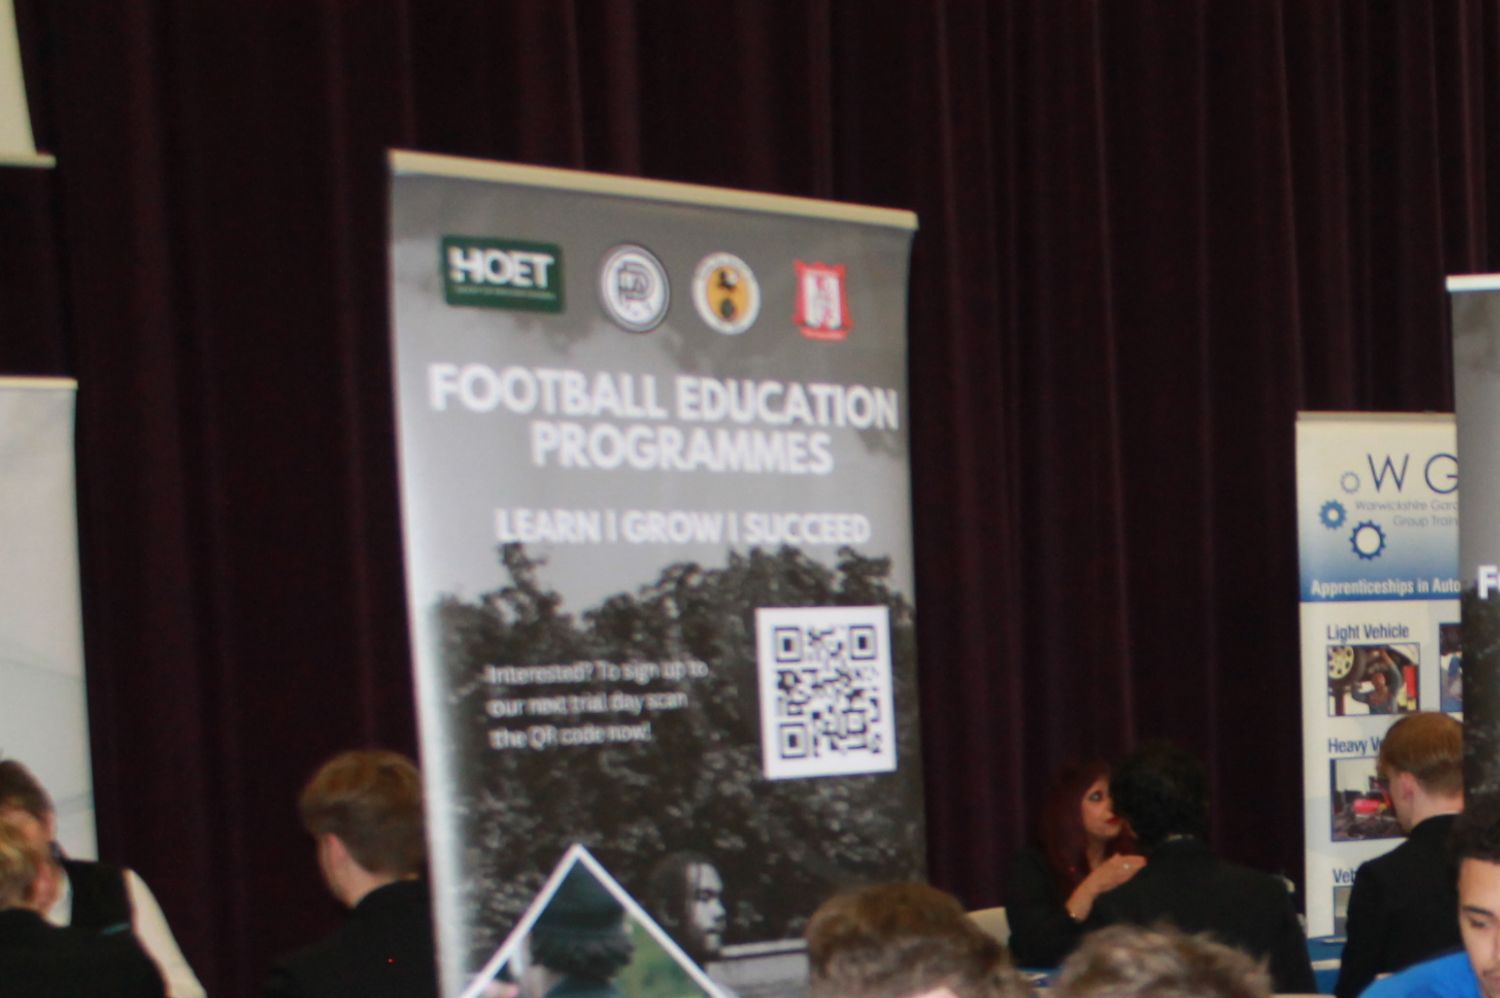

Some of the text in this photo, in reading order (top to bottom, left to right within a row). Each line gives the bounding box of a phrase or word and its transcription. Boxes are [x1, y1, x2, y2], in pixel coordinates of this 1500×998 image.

[449, 246, 556, 289] HOET
[429, 363, 899, 430] FOOTBALL EDUCATION
[530, 419, 834, 475] PROGRAMMES
[494, 510, 598, 543] LEARN
[622, 512, 723, 543] GROW
[744, 512, 870, 544] SUCCEED
[1311, 579, 1414, 598] Apprenticeships
[1418, 579, 1429, 593] in
[1326, 624, 1409, 643] Light Vehicle
[1328, 737, 1367, 755] Heavy
